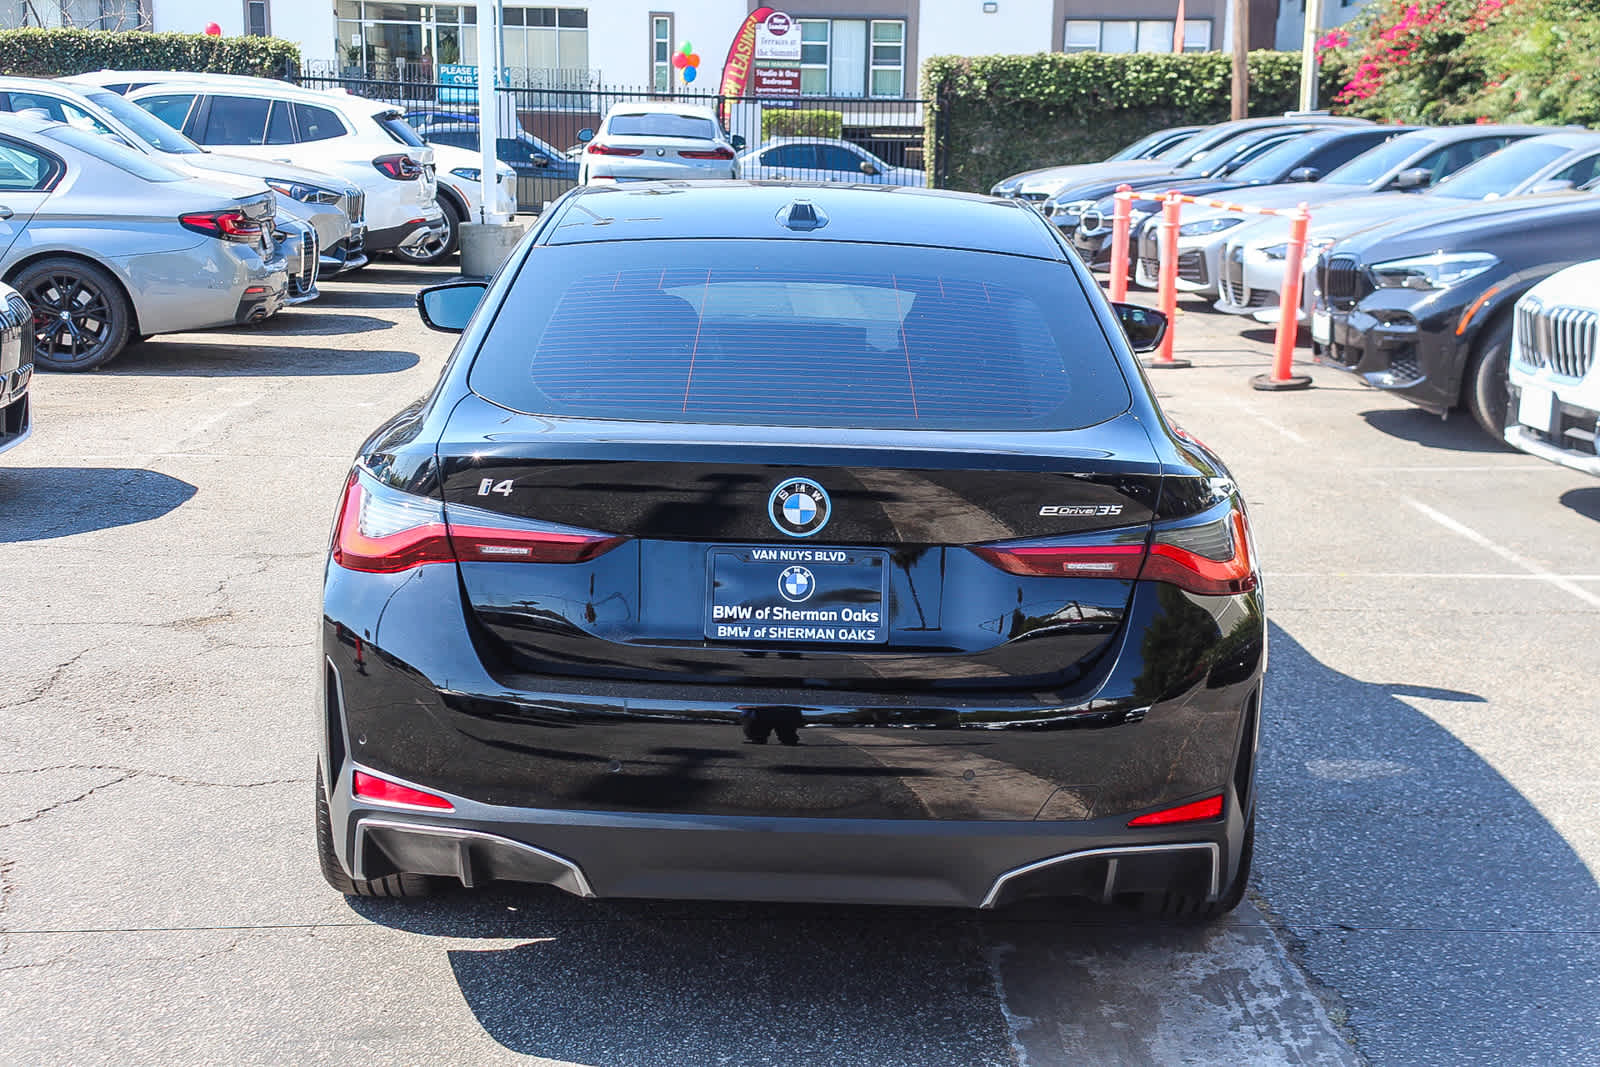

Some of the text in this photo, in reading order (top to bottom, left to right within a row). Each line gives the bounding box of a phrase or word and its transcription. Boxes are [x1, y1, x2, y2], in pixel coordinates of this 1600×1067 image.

[440, 66, 472, 75] PLEASE
[454, 75, 472, 84] OUR
[477, 478, 514, 496] i4
[752, 549, 846, 562] VAN NUYS BLVD
[713, 605, 879, 622] BMW of Sherman Oaks
[718, 626, 876, 641] BMW of SHERMAN OAKS
